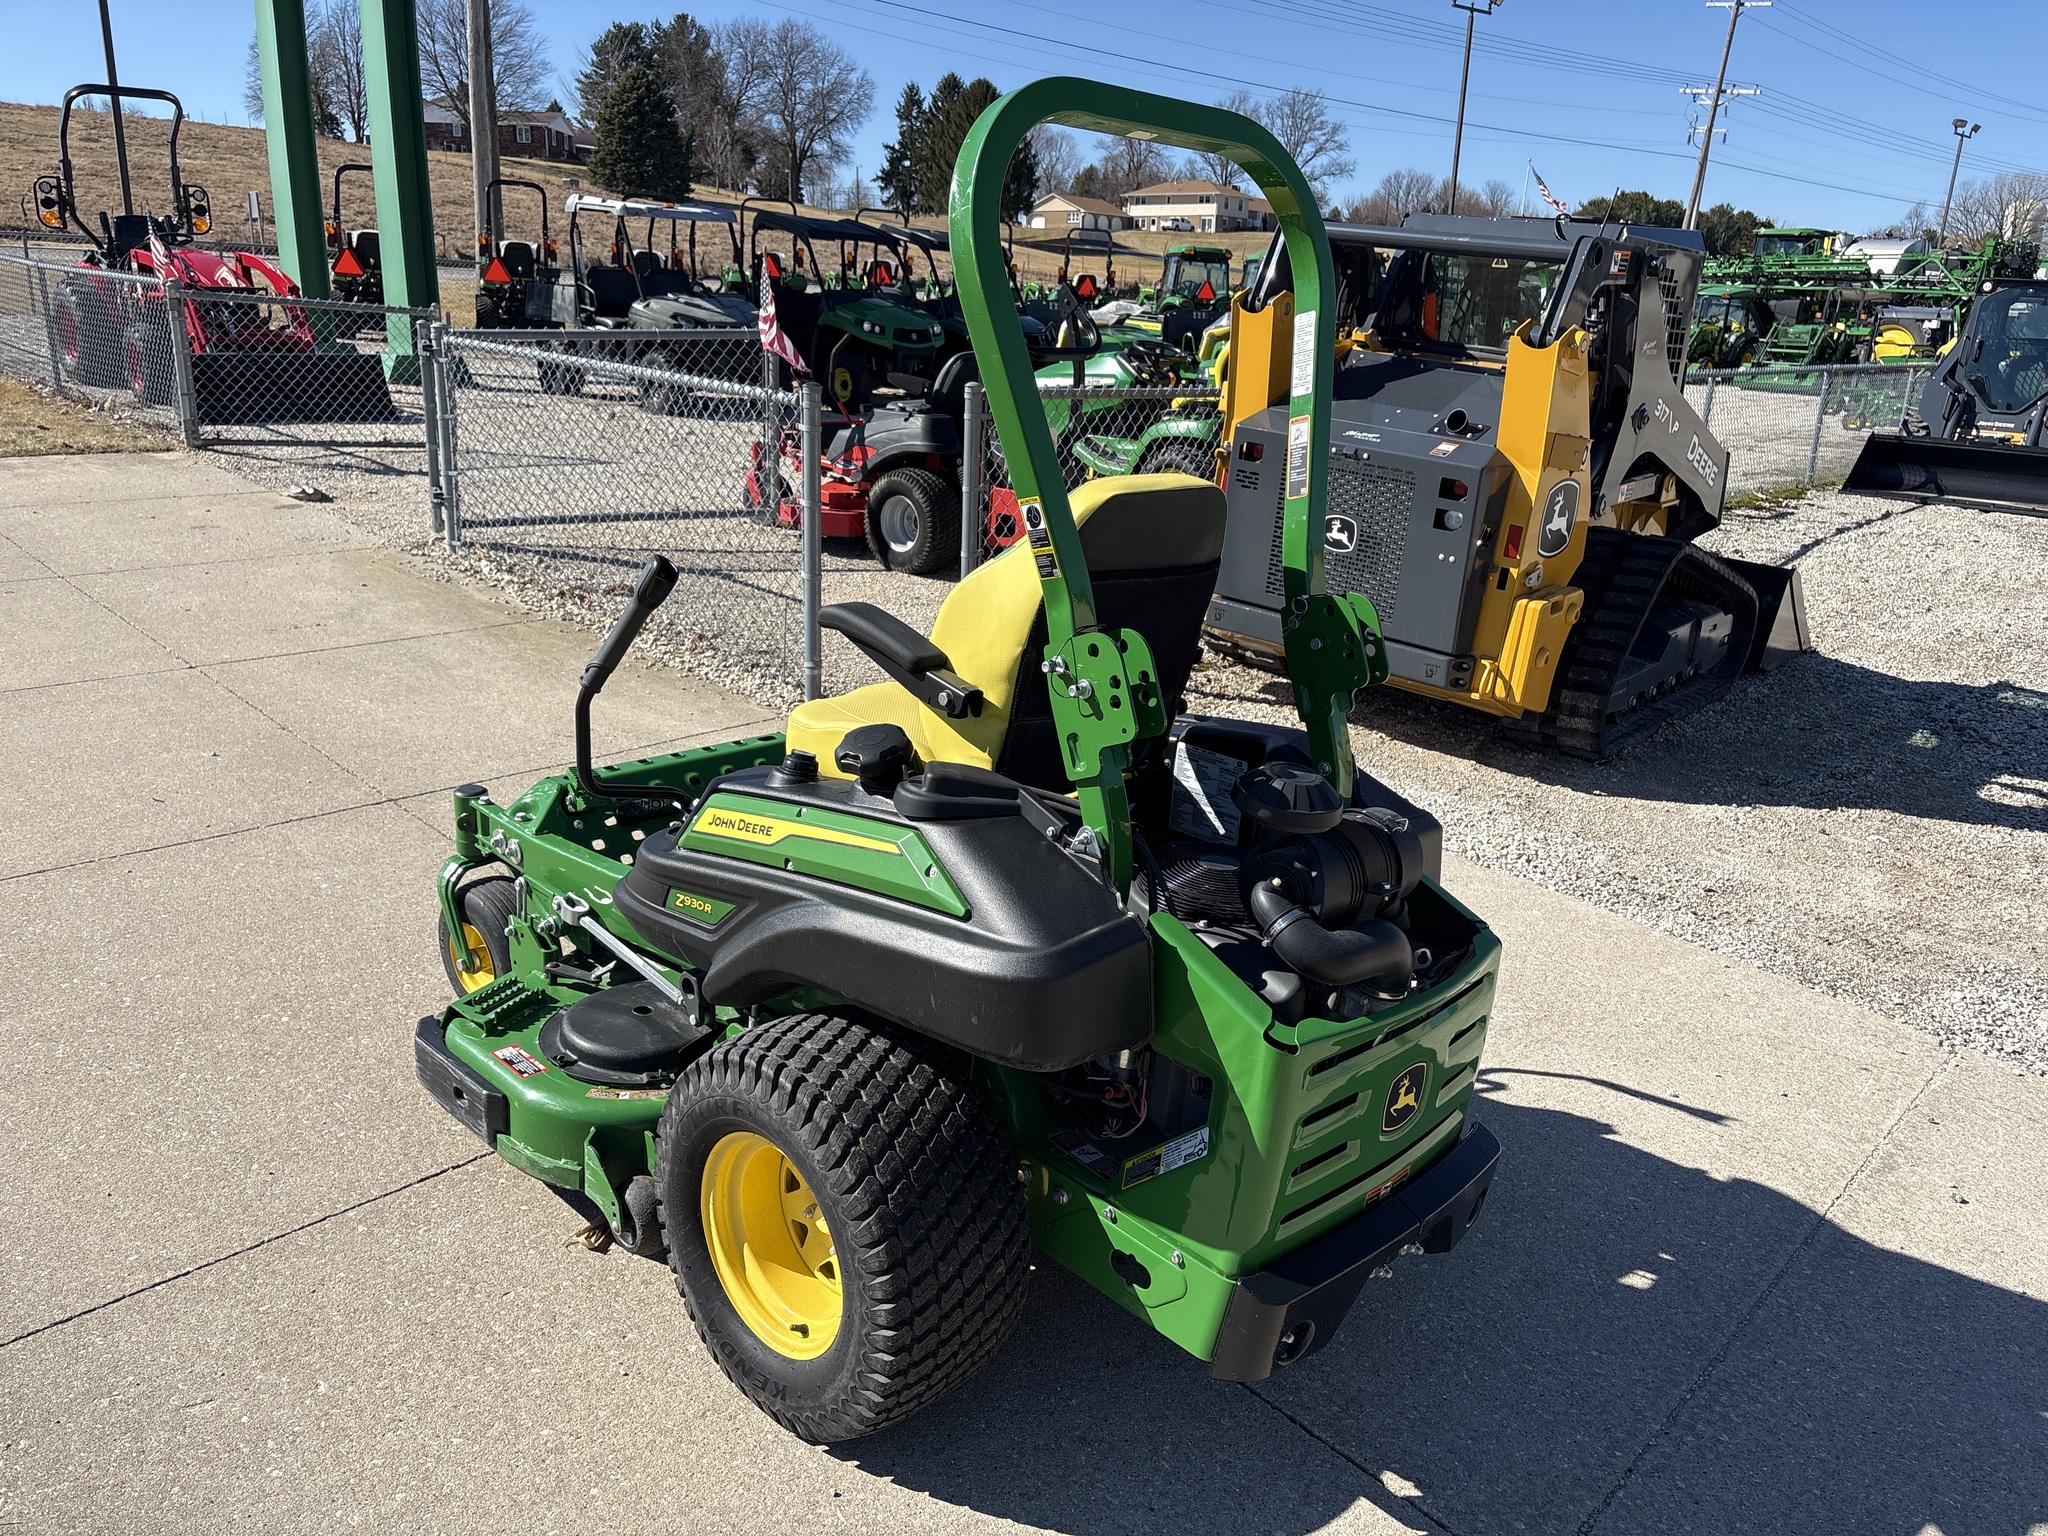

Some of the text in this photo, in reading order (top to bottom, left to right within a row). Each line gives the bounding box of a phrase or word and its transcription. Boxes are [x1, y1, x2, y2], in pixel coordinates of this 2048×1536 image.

[1654, 398, 1670, 423] 317
[1994, 421, 2016, 429] DEERE
[1686, 433, 1719, 487] DEERE
[708, 813, 774, 837] JOHN DEERE
[675, 893, 712, 914] Z930R
[707, 1315, 788, 1401] KENDA
